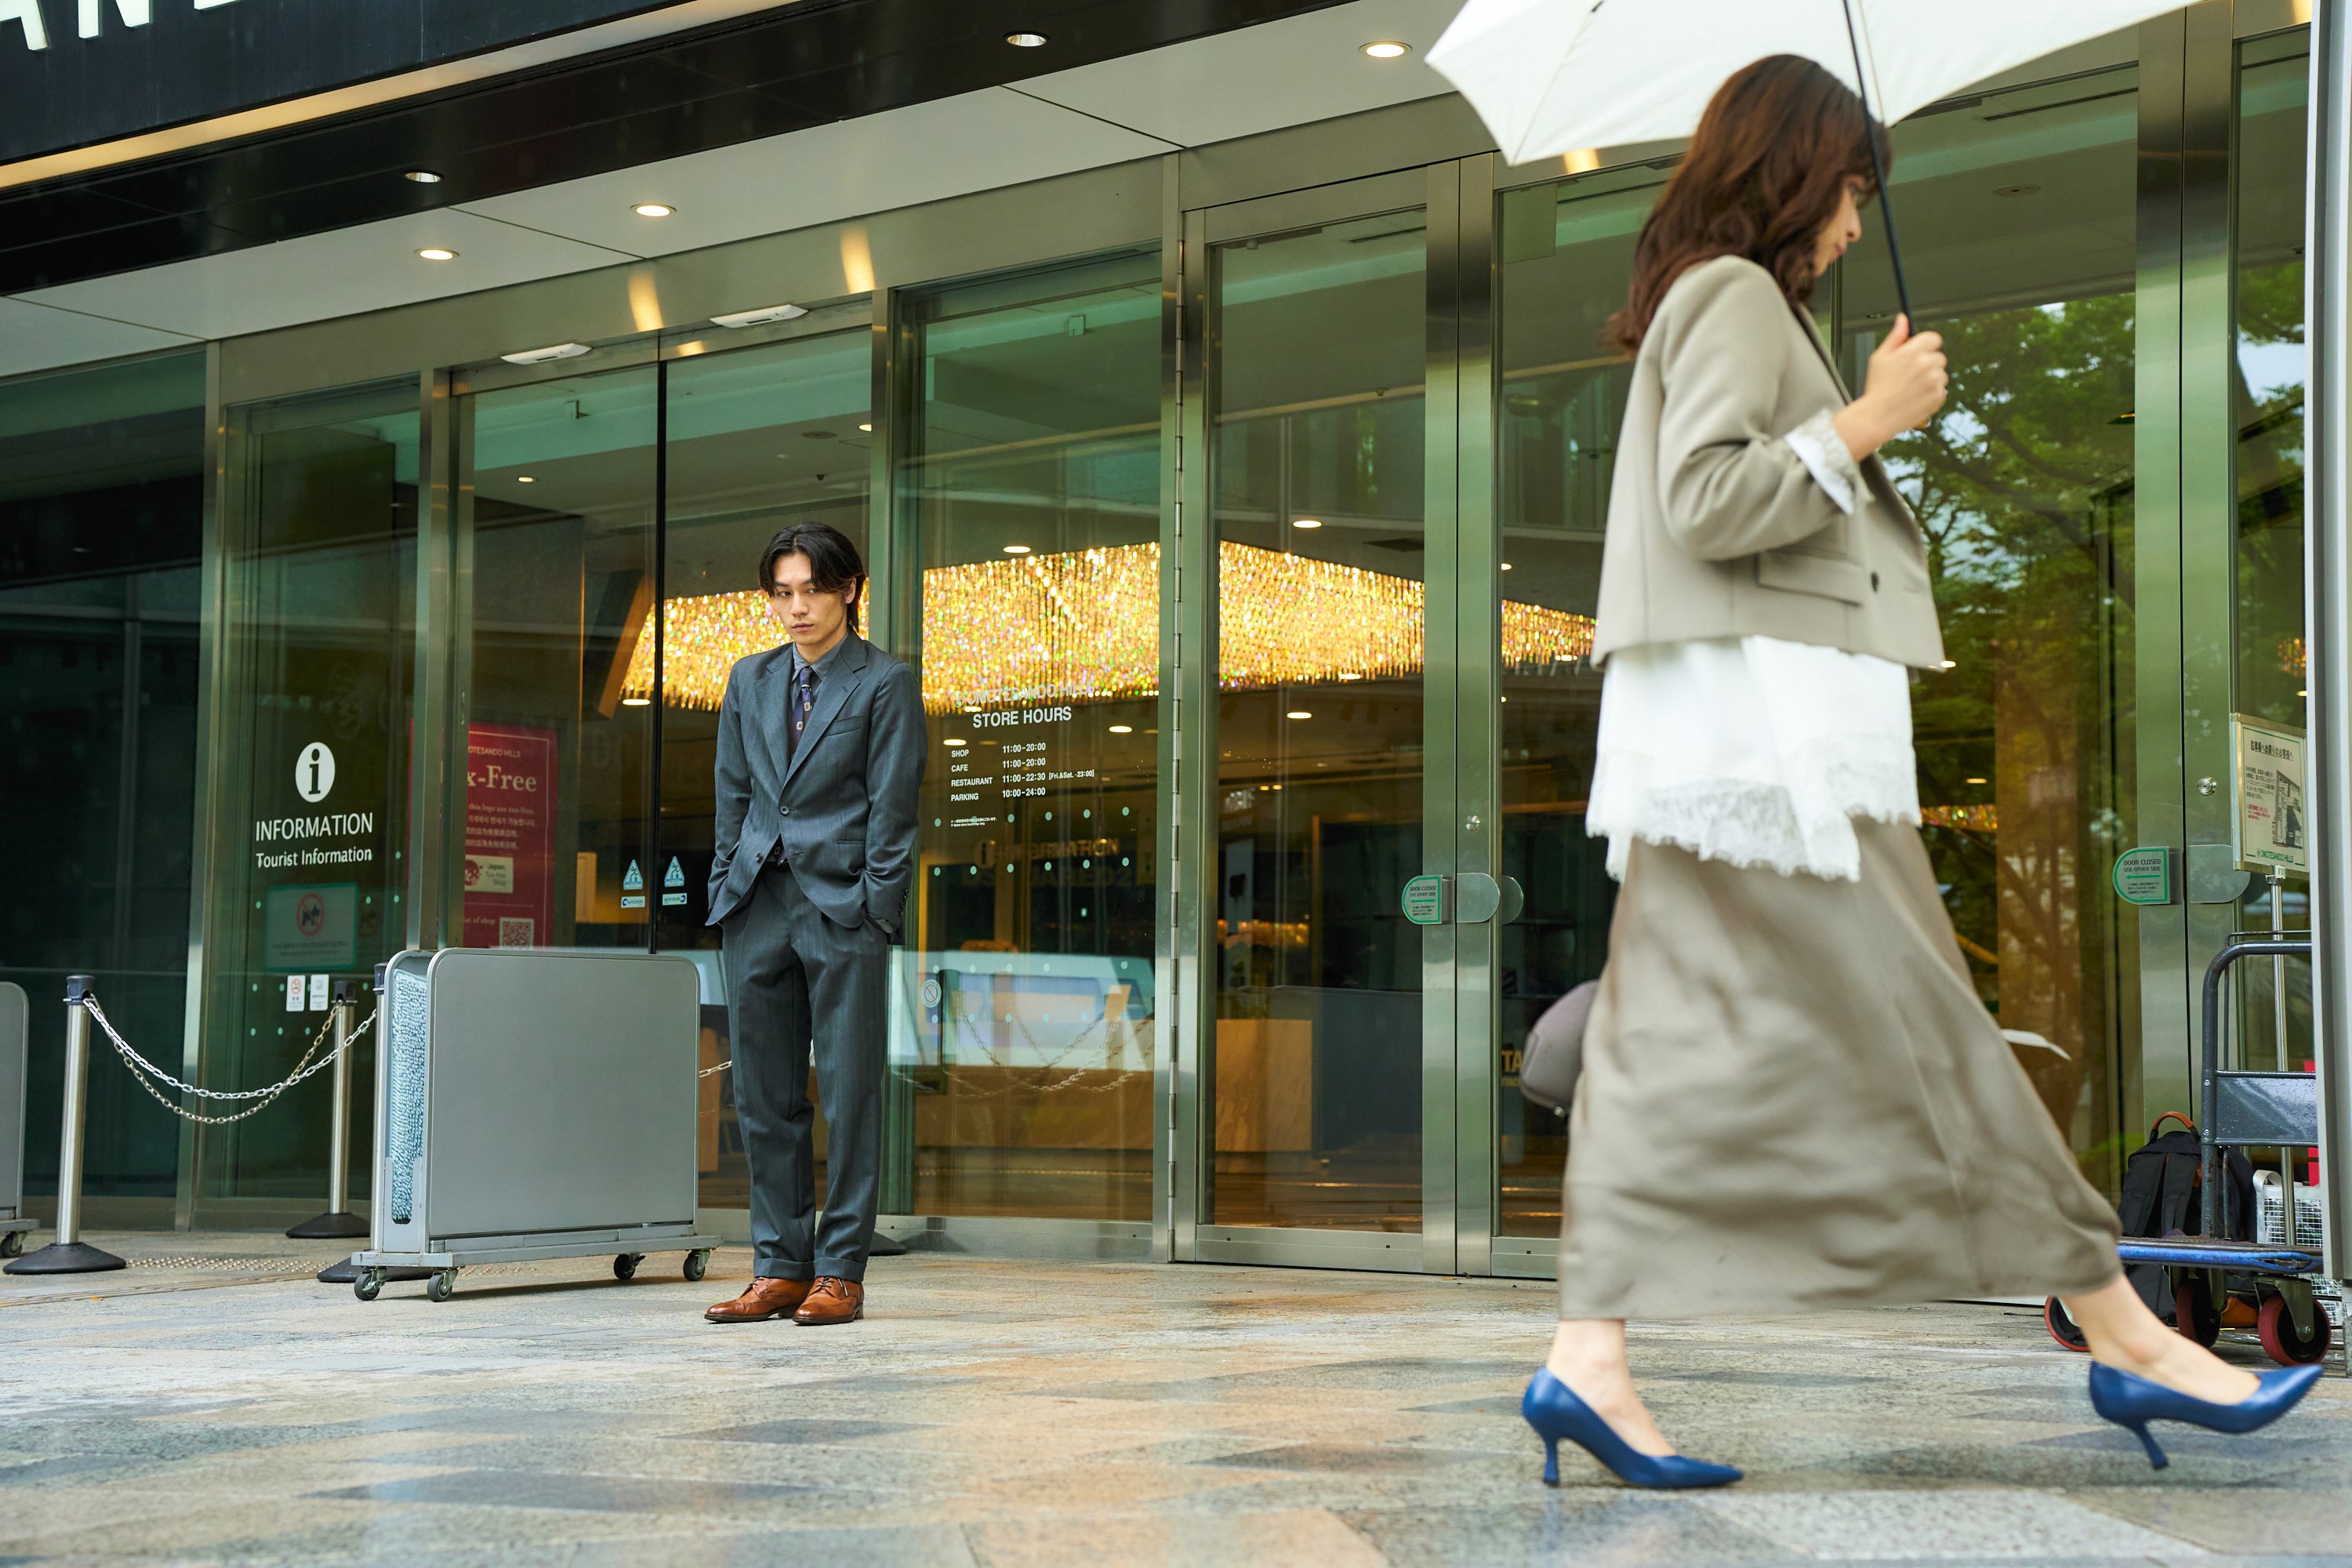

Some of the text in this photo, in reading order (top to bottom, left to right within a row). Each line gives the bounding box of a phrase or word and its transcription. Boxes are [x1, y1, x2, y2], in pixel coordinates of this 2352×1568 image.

[967, 684, 1056, 705] OMOTESANDO
[973, 706, 1072, 728] STORE HOURS
[951, 742, 1046, 758] SHOP 11:00-20:00
[1002, 757, 1046, 768] 11:00-20:00
[951, 777, 993, 787] RESTAURANT
[1002, 772, 1046, 783] 11:00-22:30
[951, 787, 1046, 802] PARKING 10:00-24:00
[256, 812, 373, 842] INFORMATION
[256, 846, 372, 868] Tourist Information
